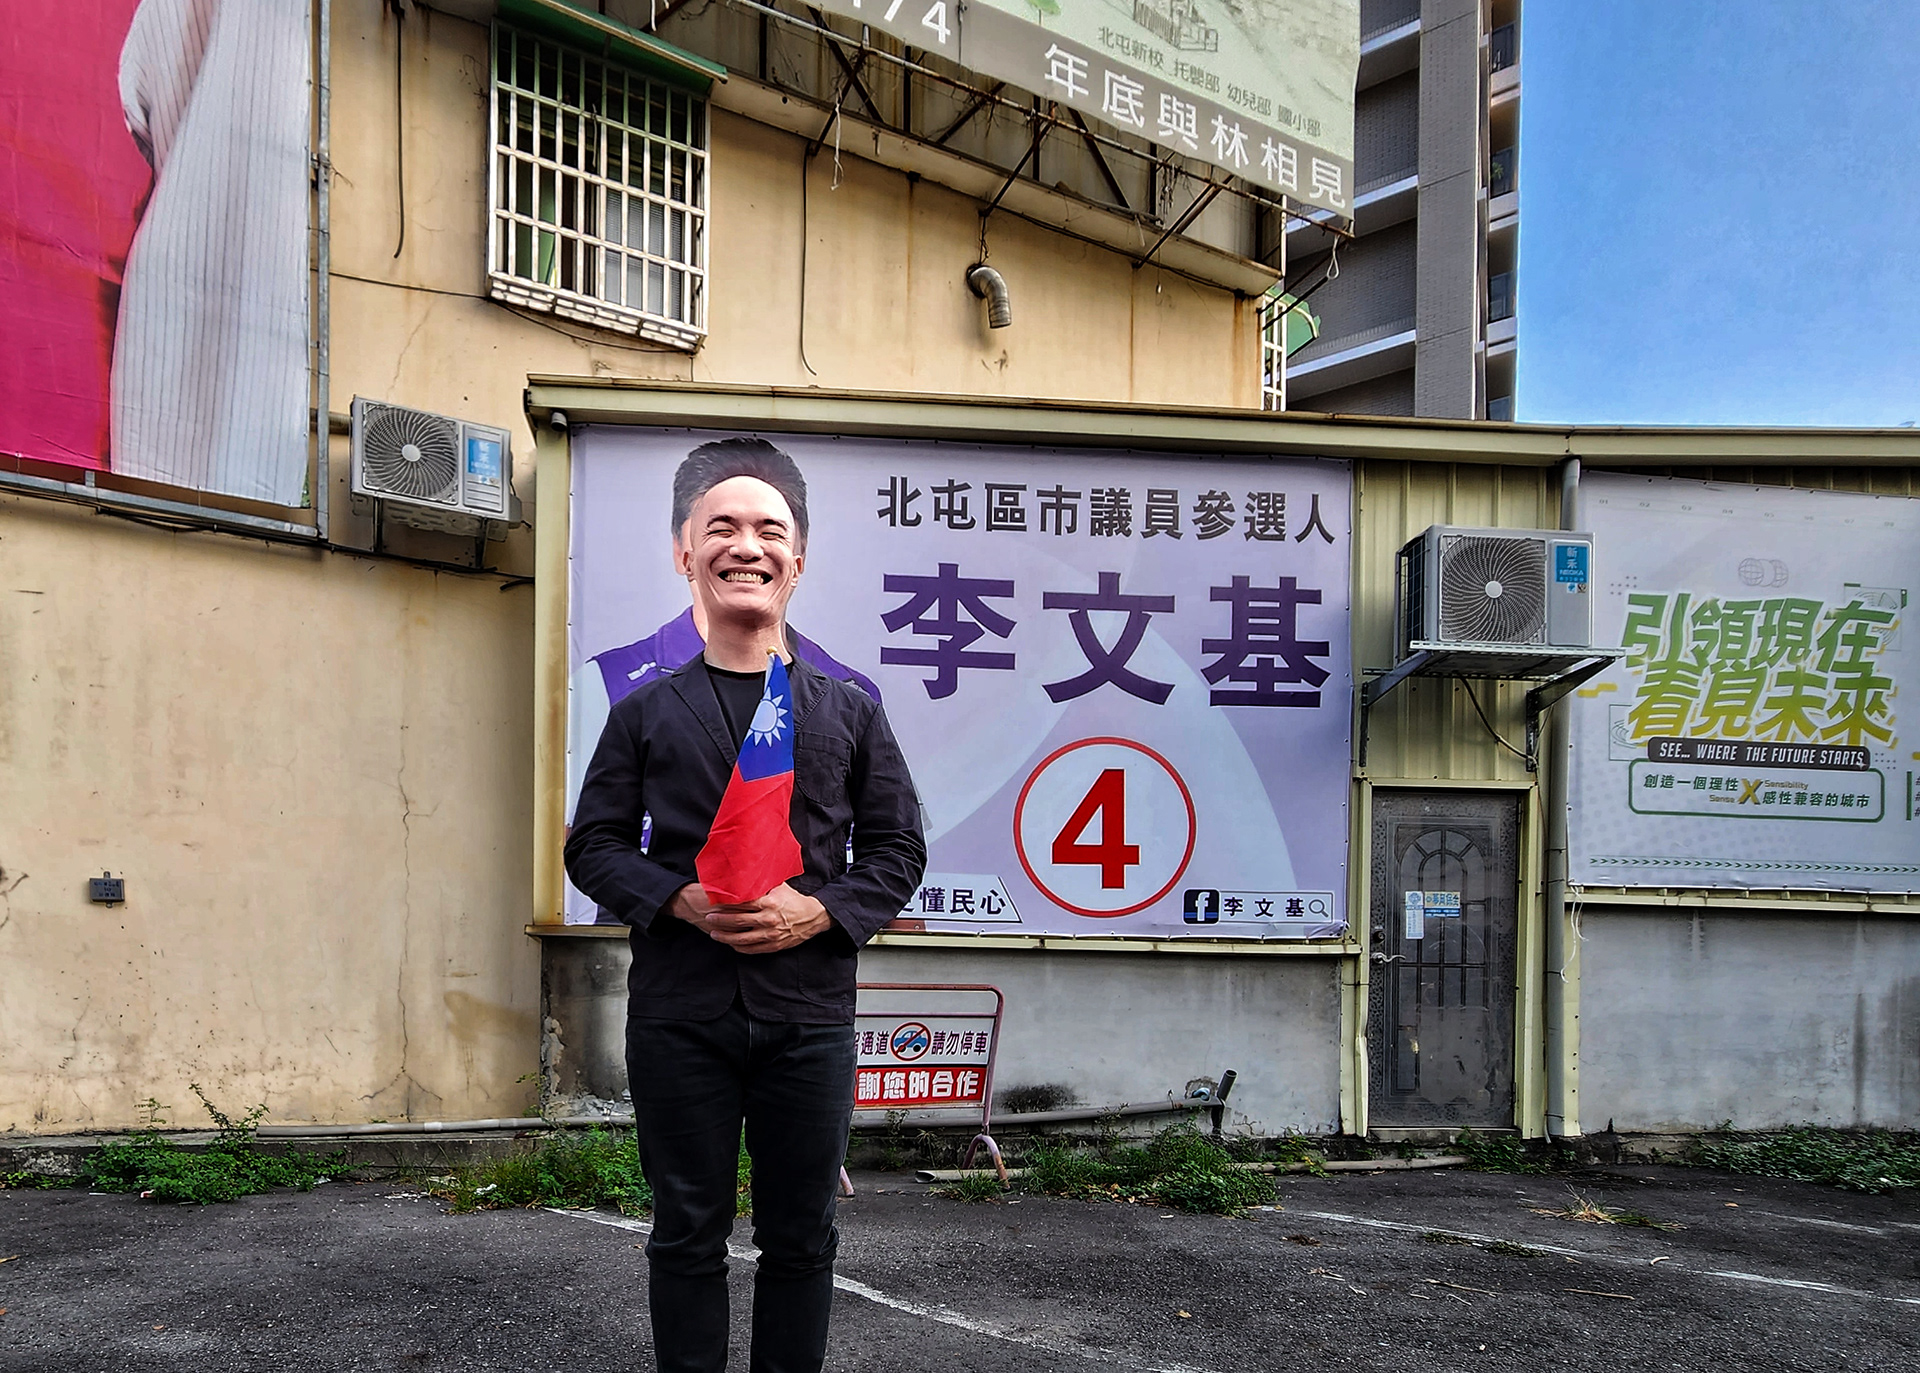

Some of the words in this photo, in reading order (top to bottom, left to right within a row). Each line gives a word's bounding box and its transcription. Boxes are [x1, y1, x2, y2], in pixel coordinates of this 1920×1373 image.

[1098, 26, 1164, 70] 北屯新校
[1044, 43, 1346, 209] 年底與林相見
[876, 476, 1336, 544] 北屯區市議員參選人
[879, 562, 1331, 708] 李文基
[1621, 593, 1896, 674] 引領現在
[1696, 744, 1738, 761] WHERE
[1746, 746, 1767, 762] THE
[1771, 747, 1816, 764] FUTURE
[1819, 749, 1865, 767] STARTS
[1643, 773, 1738, 792] 創造一個理性
[1764, 780, 1809, 790] Sensibility
[1709, 795, 1736, 804] Sense
[1762, 791, 1871, 808] 感性兼容的城市
[1051, 768, 1141, 890] 4
[902, 887, 1006, 915] 懂民心
[1223, 896, 1305, 918] 李文基
[855, 1031, 889, 1056] 通道
[931, 1030, 989, 1056] 請勿停車
[858, 1070, 980, 1100] 謝您的合作
